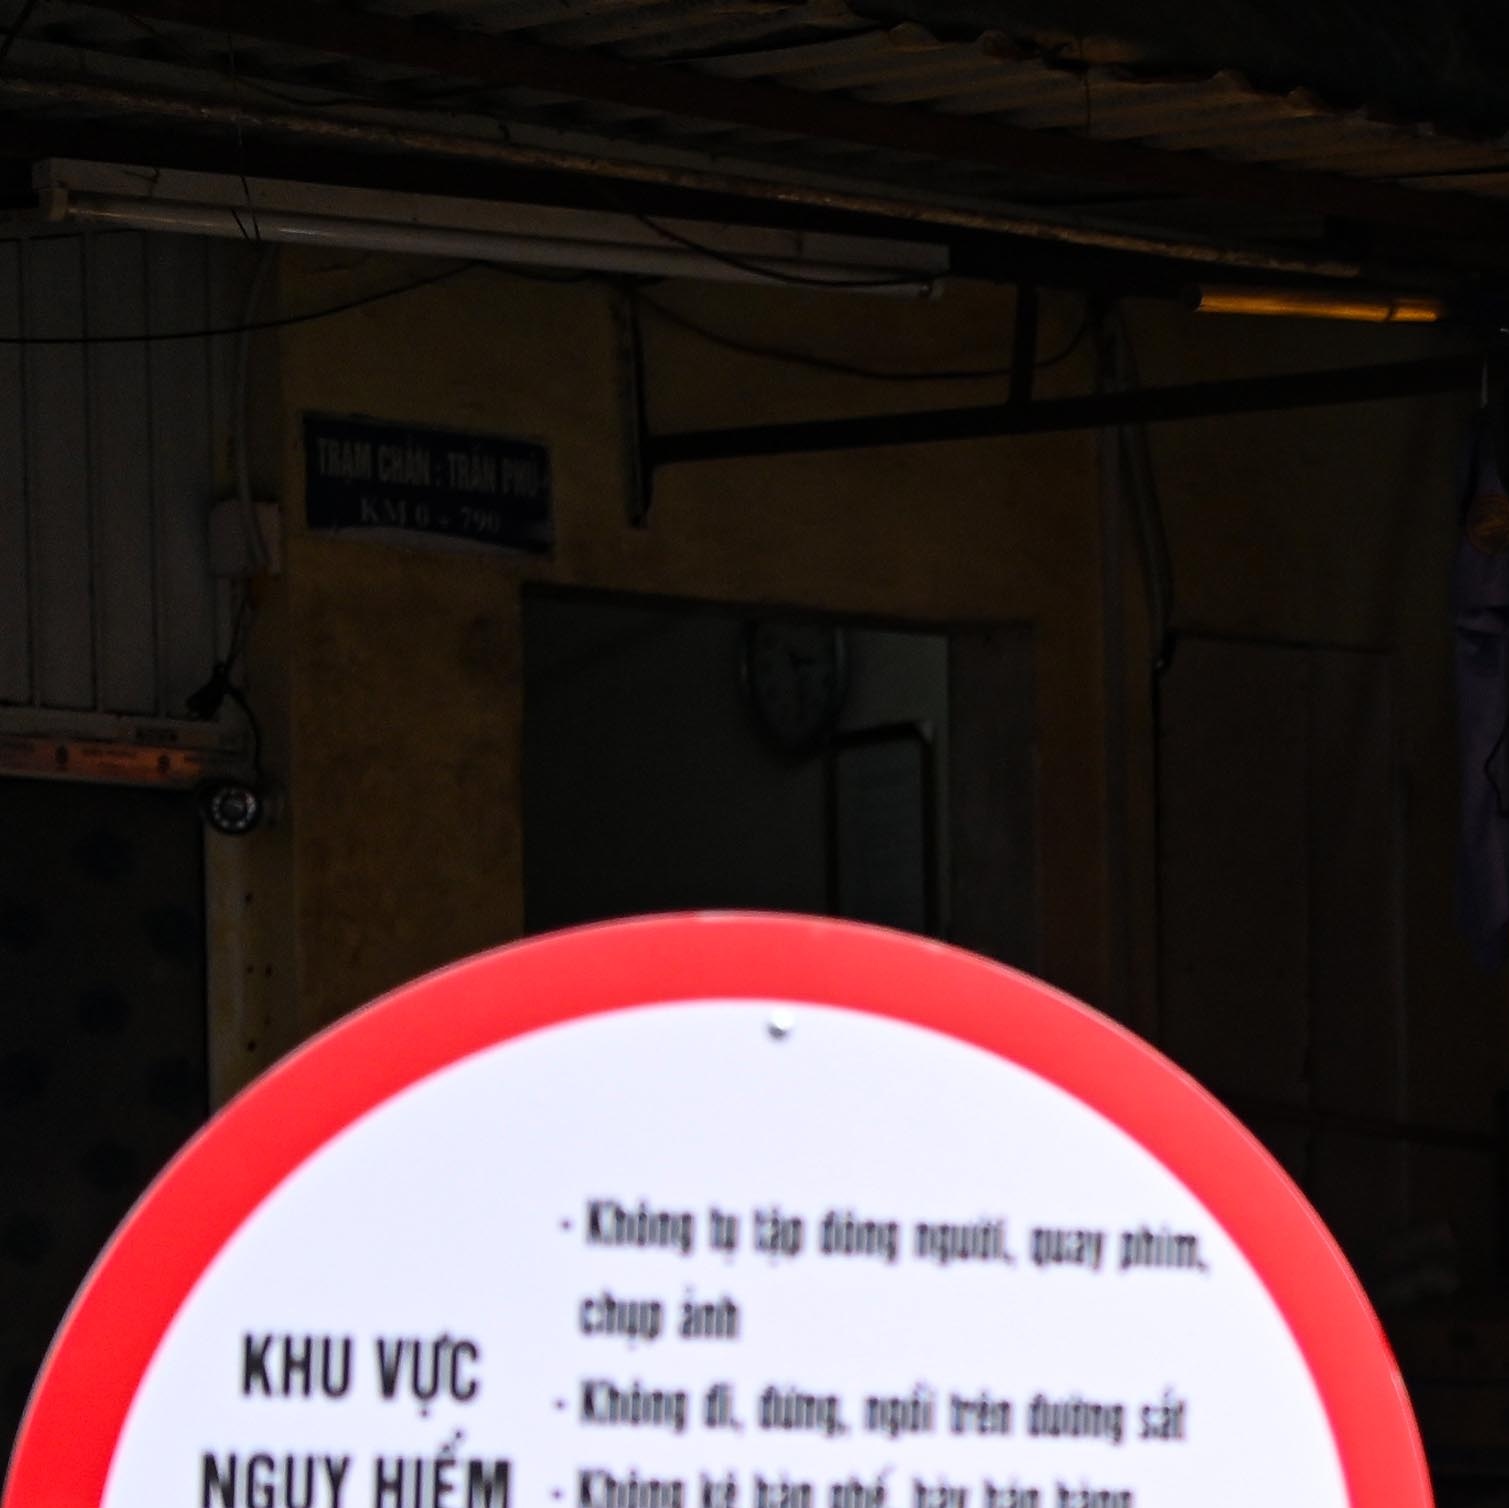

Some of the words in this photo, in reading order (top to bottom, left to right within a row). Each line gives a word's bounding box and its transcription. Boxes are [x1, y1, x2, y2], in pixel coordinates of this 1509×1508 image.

[1031, 1227, 1103, 1271] quay
[1119, 1225, 1208, 1272] phim,
[242, 1332, 352, 1399] KHU
[376, 1332, 480, 1417] VỰC
